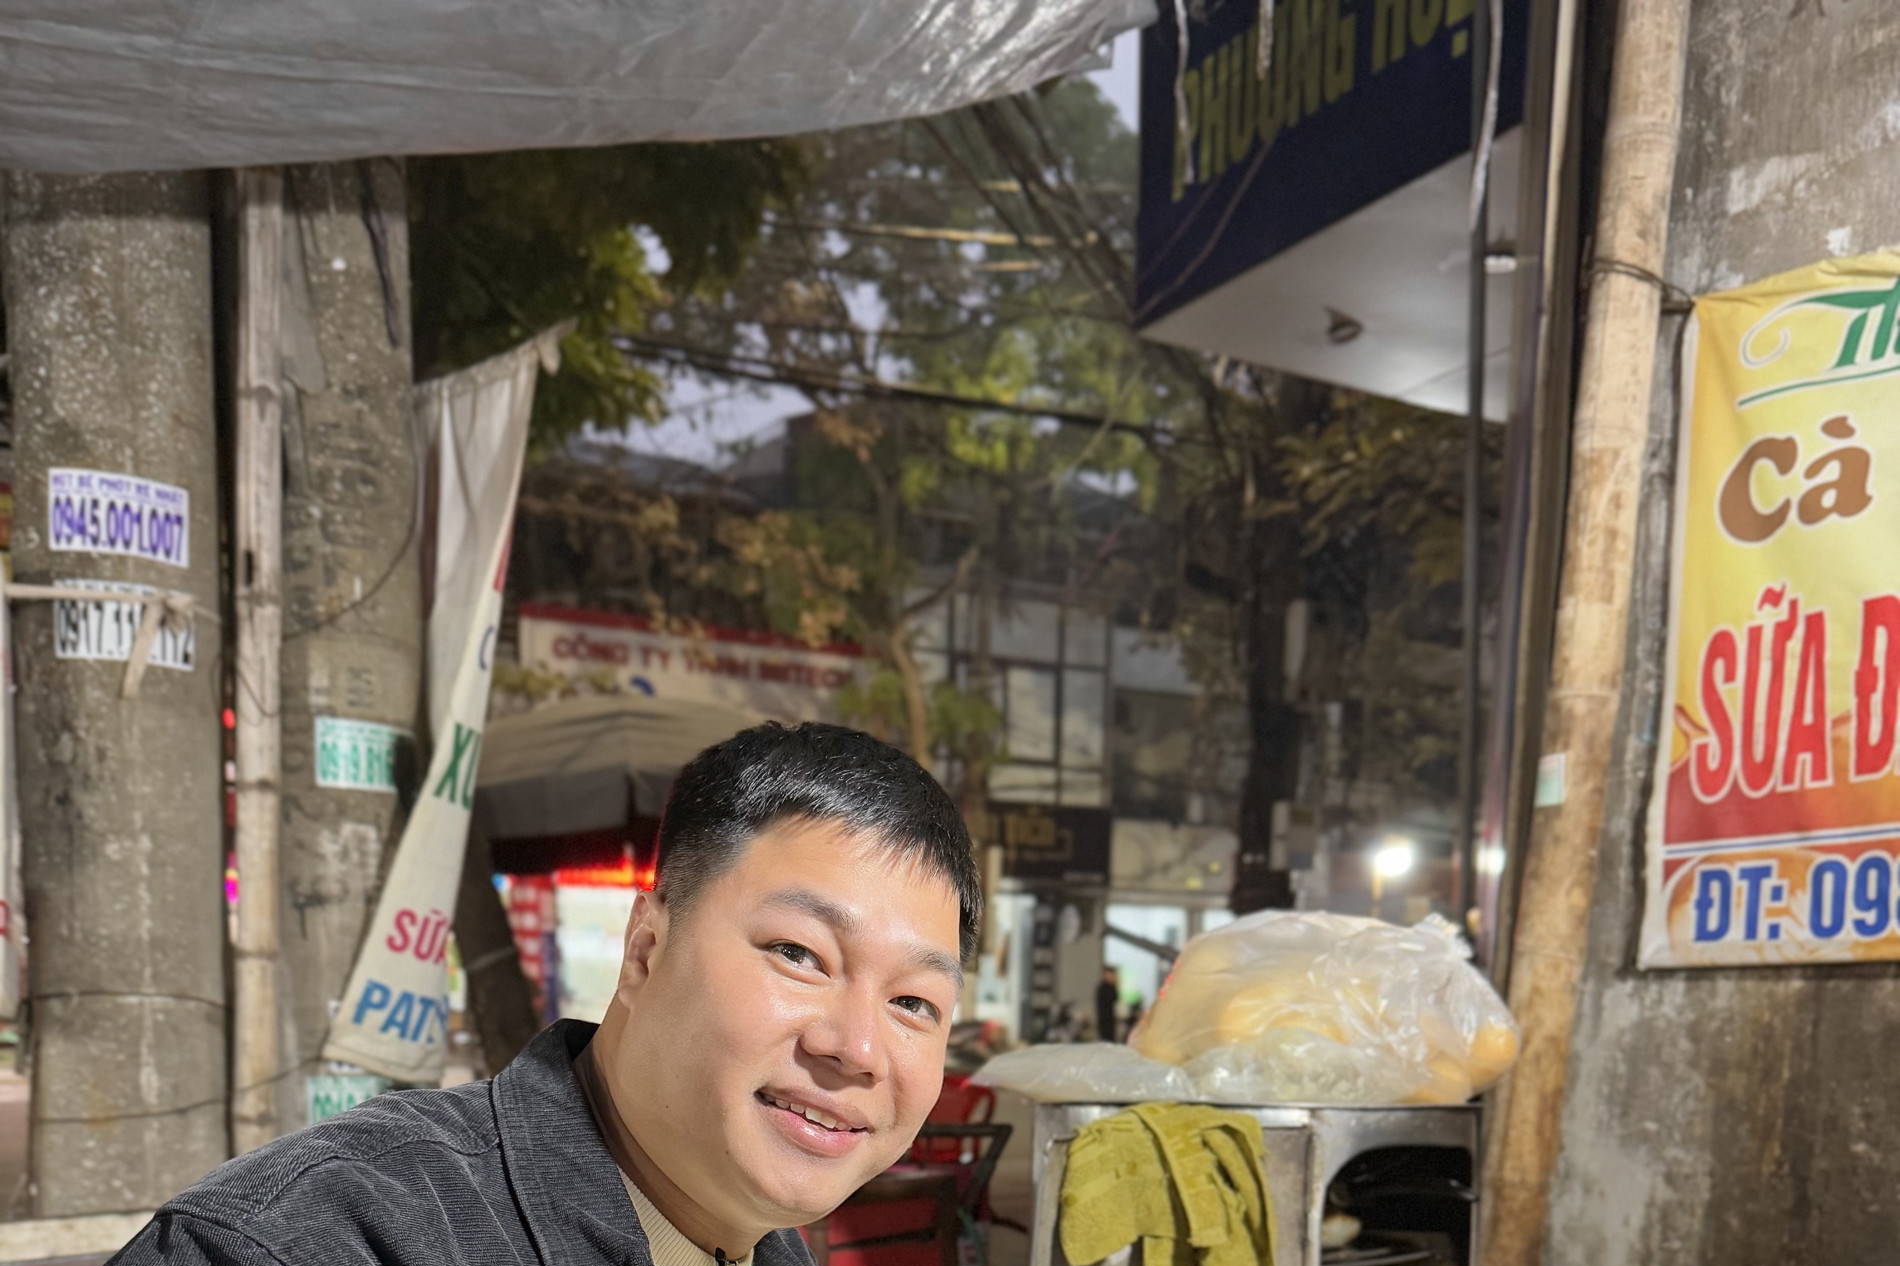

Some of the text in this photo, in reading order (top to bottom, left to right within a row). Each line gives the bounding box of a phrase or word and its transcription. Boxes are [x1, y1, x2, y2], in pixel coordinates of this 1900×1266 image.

[53, 497, 184, 562] 0945.001.007
[1693, 582, 1900, 801] SỮA Đ
[1693, 855, 1900, 943] ĐT: 09
[386, 908, 449, 966] SỮ
[352, 979, 450, 1045] PAT
